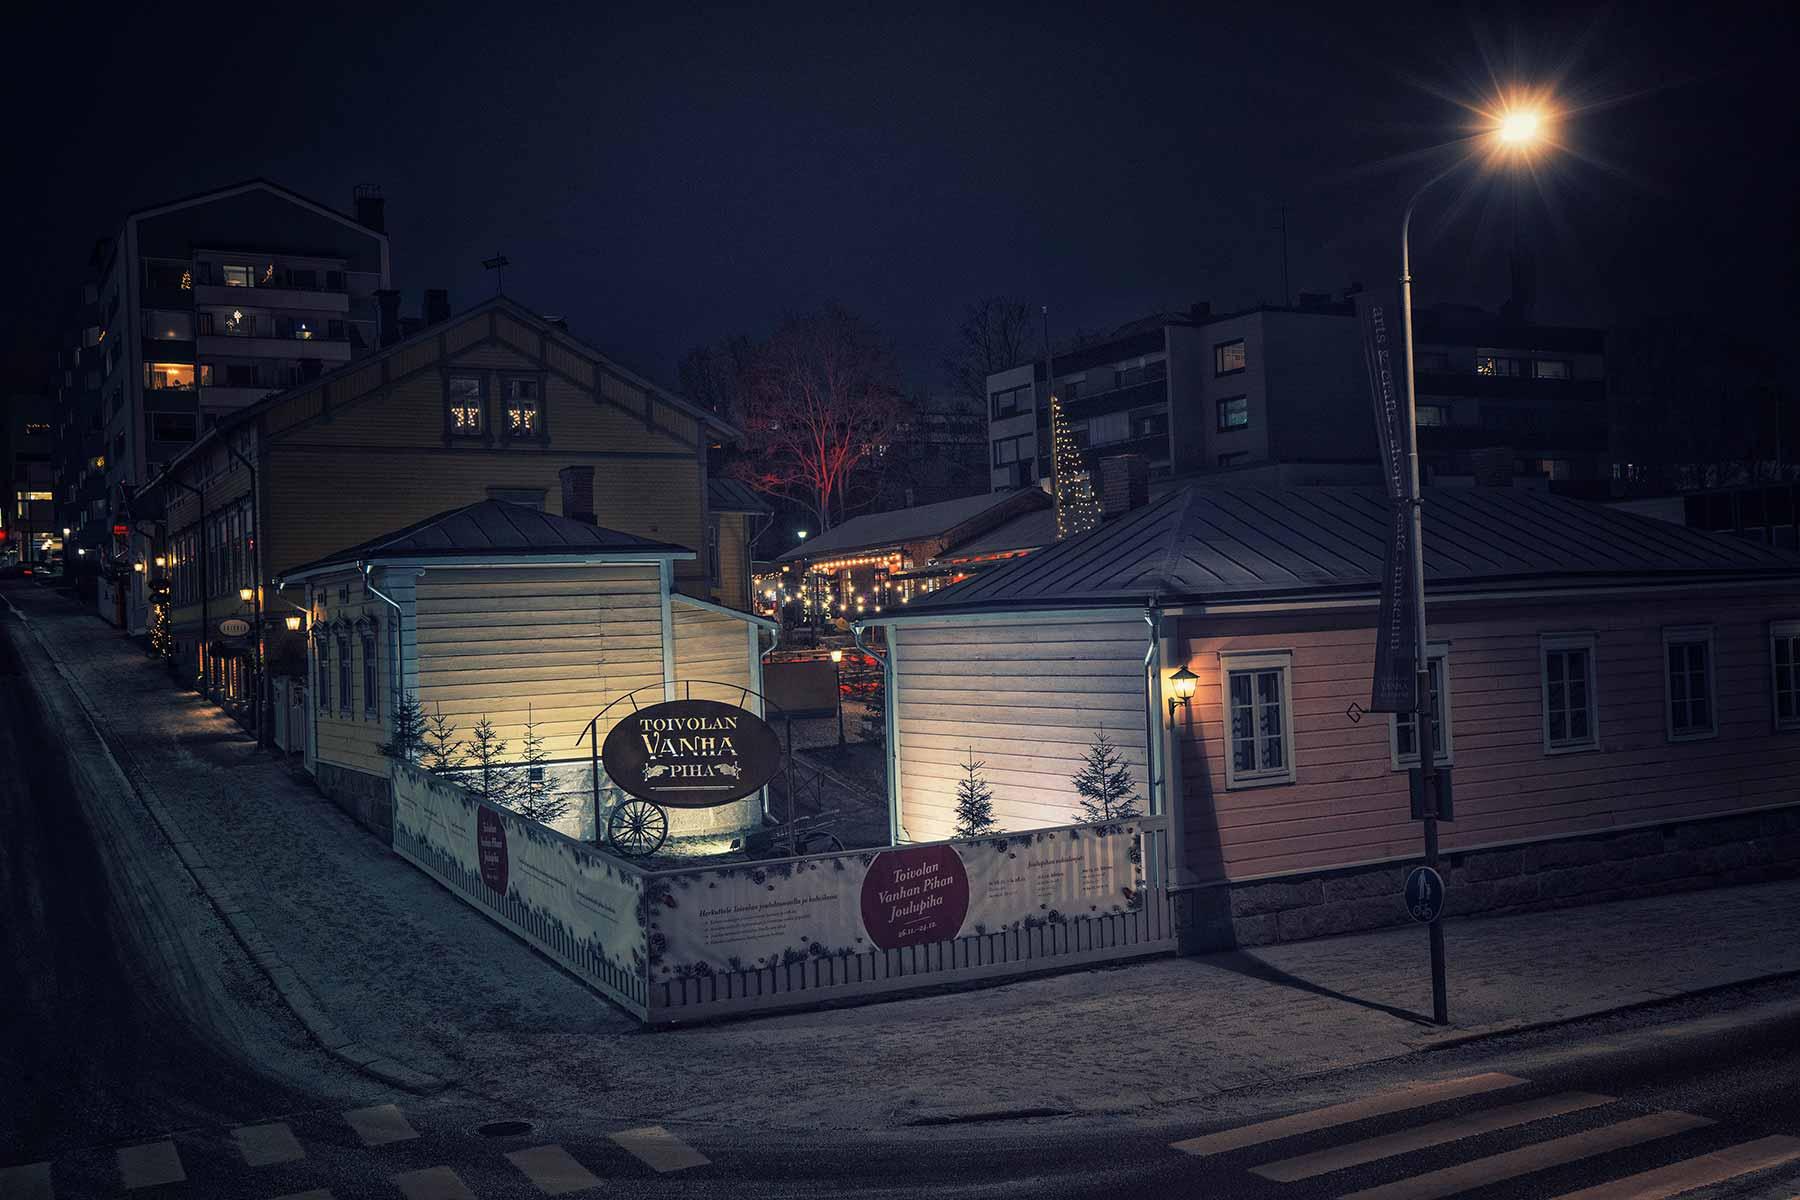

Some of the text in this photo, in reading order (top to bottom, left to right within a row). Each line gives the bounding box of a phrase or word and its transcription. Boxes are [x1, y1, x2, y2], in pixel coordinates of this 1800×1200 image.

[1372, 306, 1386, 344] arts
[1391, 567, 1404, 650] museum
[640, 716, 739, 731] TOIVOLAN
[641, 731, 738, 760] VANHA
[670, 763, 716, 777] PIHA
[893, 862, 939, 883] Toivolan
[878, 876, 954, 904] Vanhan Pihan
[888, 894, 944, 924] Joulupiha
